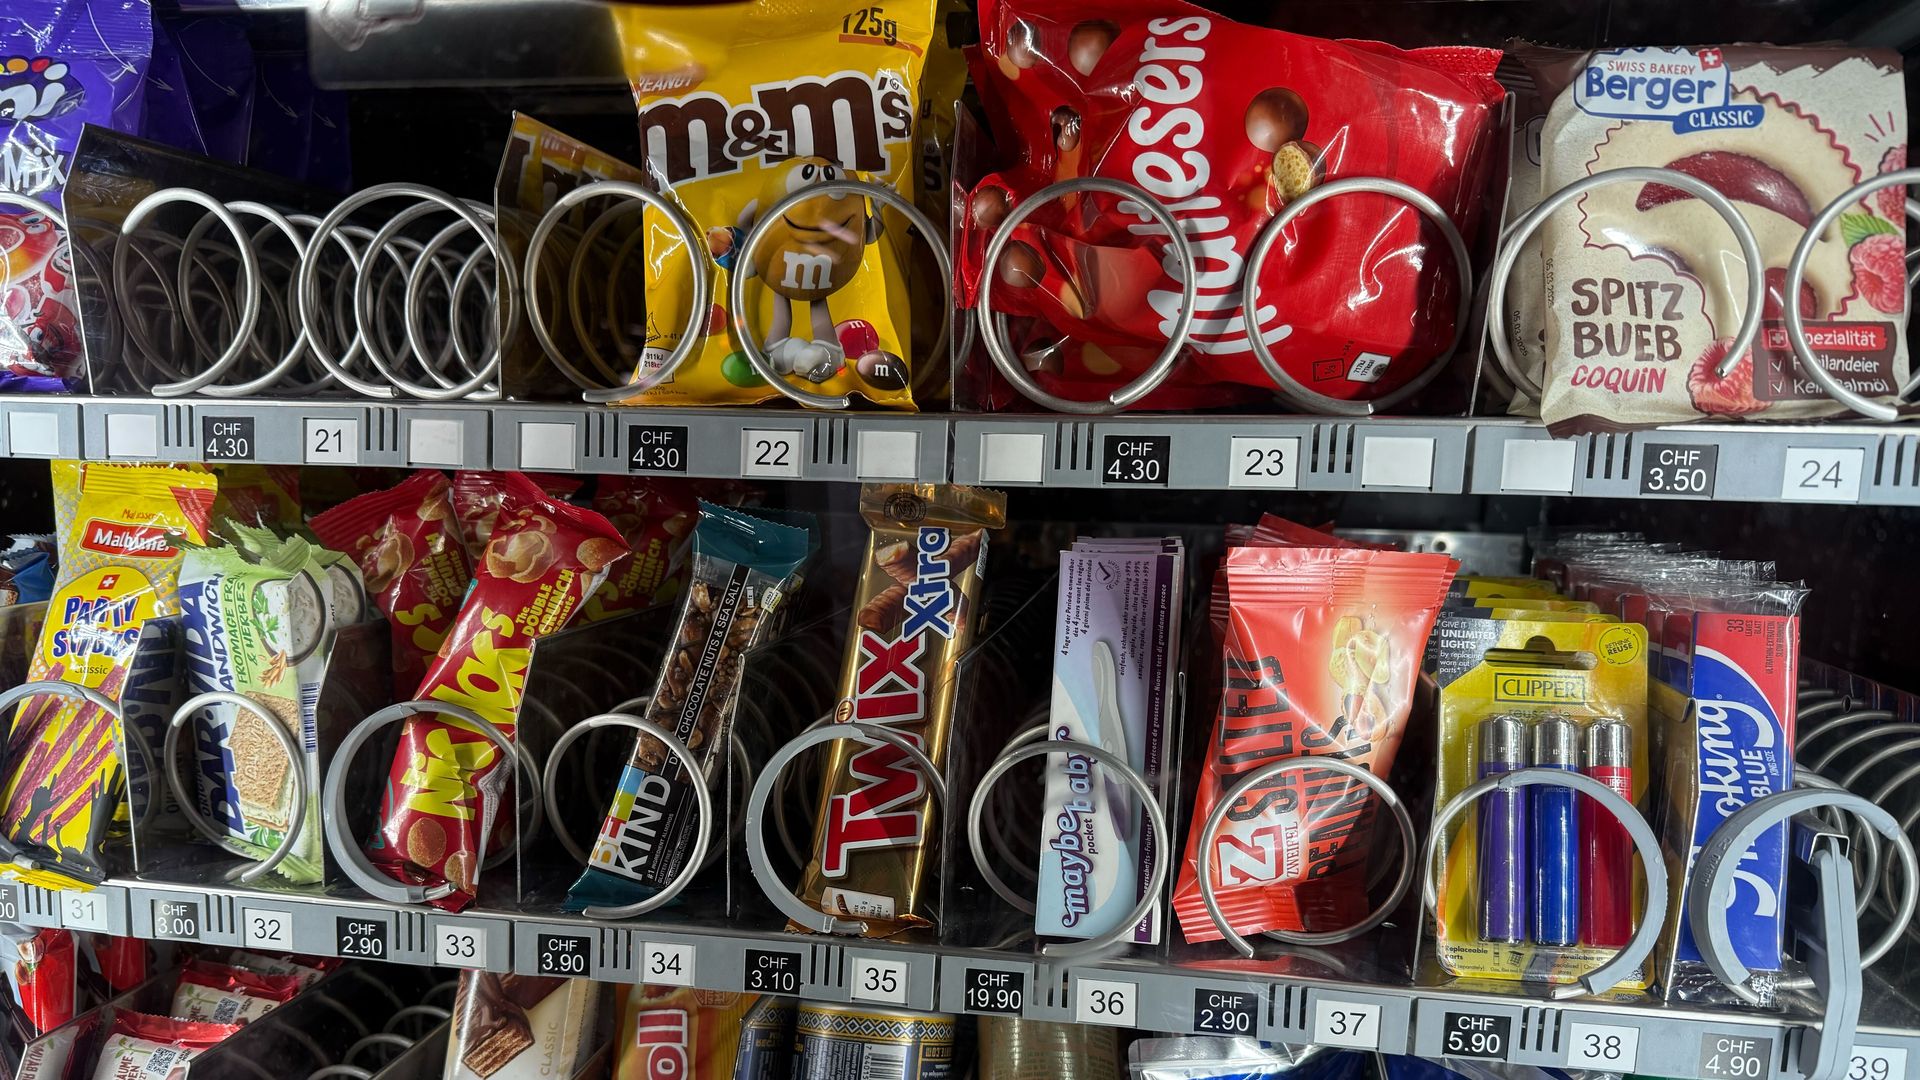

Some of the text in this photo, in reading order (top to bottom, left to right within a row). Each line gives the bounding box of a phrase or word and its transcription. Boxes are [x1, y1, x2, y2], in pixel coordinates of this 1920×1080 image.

[842, 8, 897, 46] 125g
[1608, 60, 1695, 75] SWISS BAKERY
[1585, 66, 1716, 110] Berger
[1688, 110, 1754, 128] CLASSIC
[1117, 17, 1293, 356] Maltesers
[780, 251, 833, 290] m
[1571, 277, 1684, 321] SPITZ
[1573, 322, 1682, 362] BUEB
[1806, 330, 1876, 347] pezialität
[874, 364, 889, 377] m
[213, 423, 241, 436] CHF
[314, 428, 343, 453] 21
[640, 431, 673, 445] CHF
[206, 438, 249, 458] 4.30
[632, 448, 680, 468] 4.30
[755, 440, 790, 466] 22
[1117, 442, 1154, 456] CHF
[1659, 450, 1701, 466] CHF
[1107, 459, 1160, 480] 4.30
[1244, 449, 1284, 477] 23
[1799, 460, 1843, 489] 24
[1648, 468, 1707, 492] 3.50
[725, 578, 742, 606] SALT
[901, 526, 954, 643] Xtra
[63, 596, 139, 627] PARTY
[521, 583, 553, 637] DOUBLE
[539, 567, 575, 635] CRUNCH
[237, 581, 258, 666] & HERBES
[516, 606, 531, 624] The
[717, 605, 731, 629] SEA
[1441, 620, 1468, 629] GIVE IT
[1726, 618, 1745, 633] 33
[714, 628, 724, 638] &
[1158, 610, 1166, 646] gravidanza
[1441, 629, 1496, 640] UNLIMITED
[224, 605, 248, 684] FROMAGE
[702, 638, 720, 669] NUTS
[1440, 639, 1477, 650] LIGHTS
[1440, 650, 1449, 659] by
[1607, 642, 1634, 656] REUSE
[1502, 678, 1577, 699] CLIPPER
[679, 669, 710, 734] CHOCOLATE
[1764, 749, 1777, 764] SIZE
[1740, 748, 1773, 799] BLUE
[614, 774, 671, 880] KIND
[1087, 817, 1099, 855] pocket
[1285, 820, 1300, 878] ZWEIFEL
[71, 897, 96, 922] 31
[161, 903, 188, 917] CHF
[157, 917, 195, 936] 3.00
[253, 916, 282, 941] 32
[347, 921, 376, 936] CHF
[342, 935, 383, 956] 2.90
[445, 933, 476, 958] 33
[548, 938, 578, 953] CHF
[542, 952, 584, 973] 3.90
[651, 951, 682, 976] 34
[757, 954, 789, 970] CHF
[750, 969, 795, 991] 3.10
[864, 966, 898, 993] 35
[977, 973, 1010, 988] CHF
[966, 987, 1021, 1010] 19.90
[1089, 989, 1126, 1016] 36
[1208, 994, 1243, 1010] CHF
[1200, 1009, 1250, 1032] 2.90
[1329, 1010, 1367, 1036] 37
[1457, 1015, 1495, 1032] CHF
[540, 1021, 558, 1076] CLASSIC
[1447, 1031, 1501, 1054] 5.90
[1583, 1033, 1622, 1060] 38
[1716, 1038, 1755, 1055] CHF
[1704, 1054, 1761, 1078] 4.90
[1848, 1055, 1890, 1080] 39
